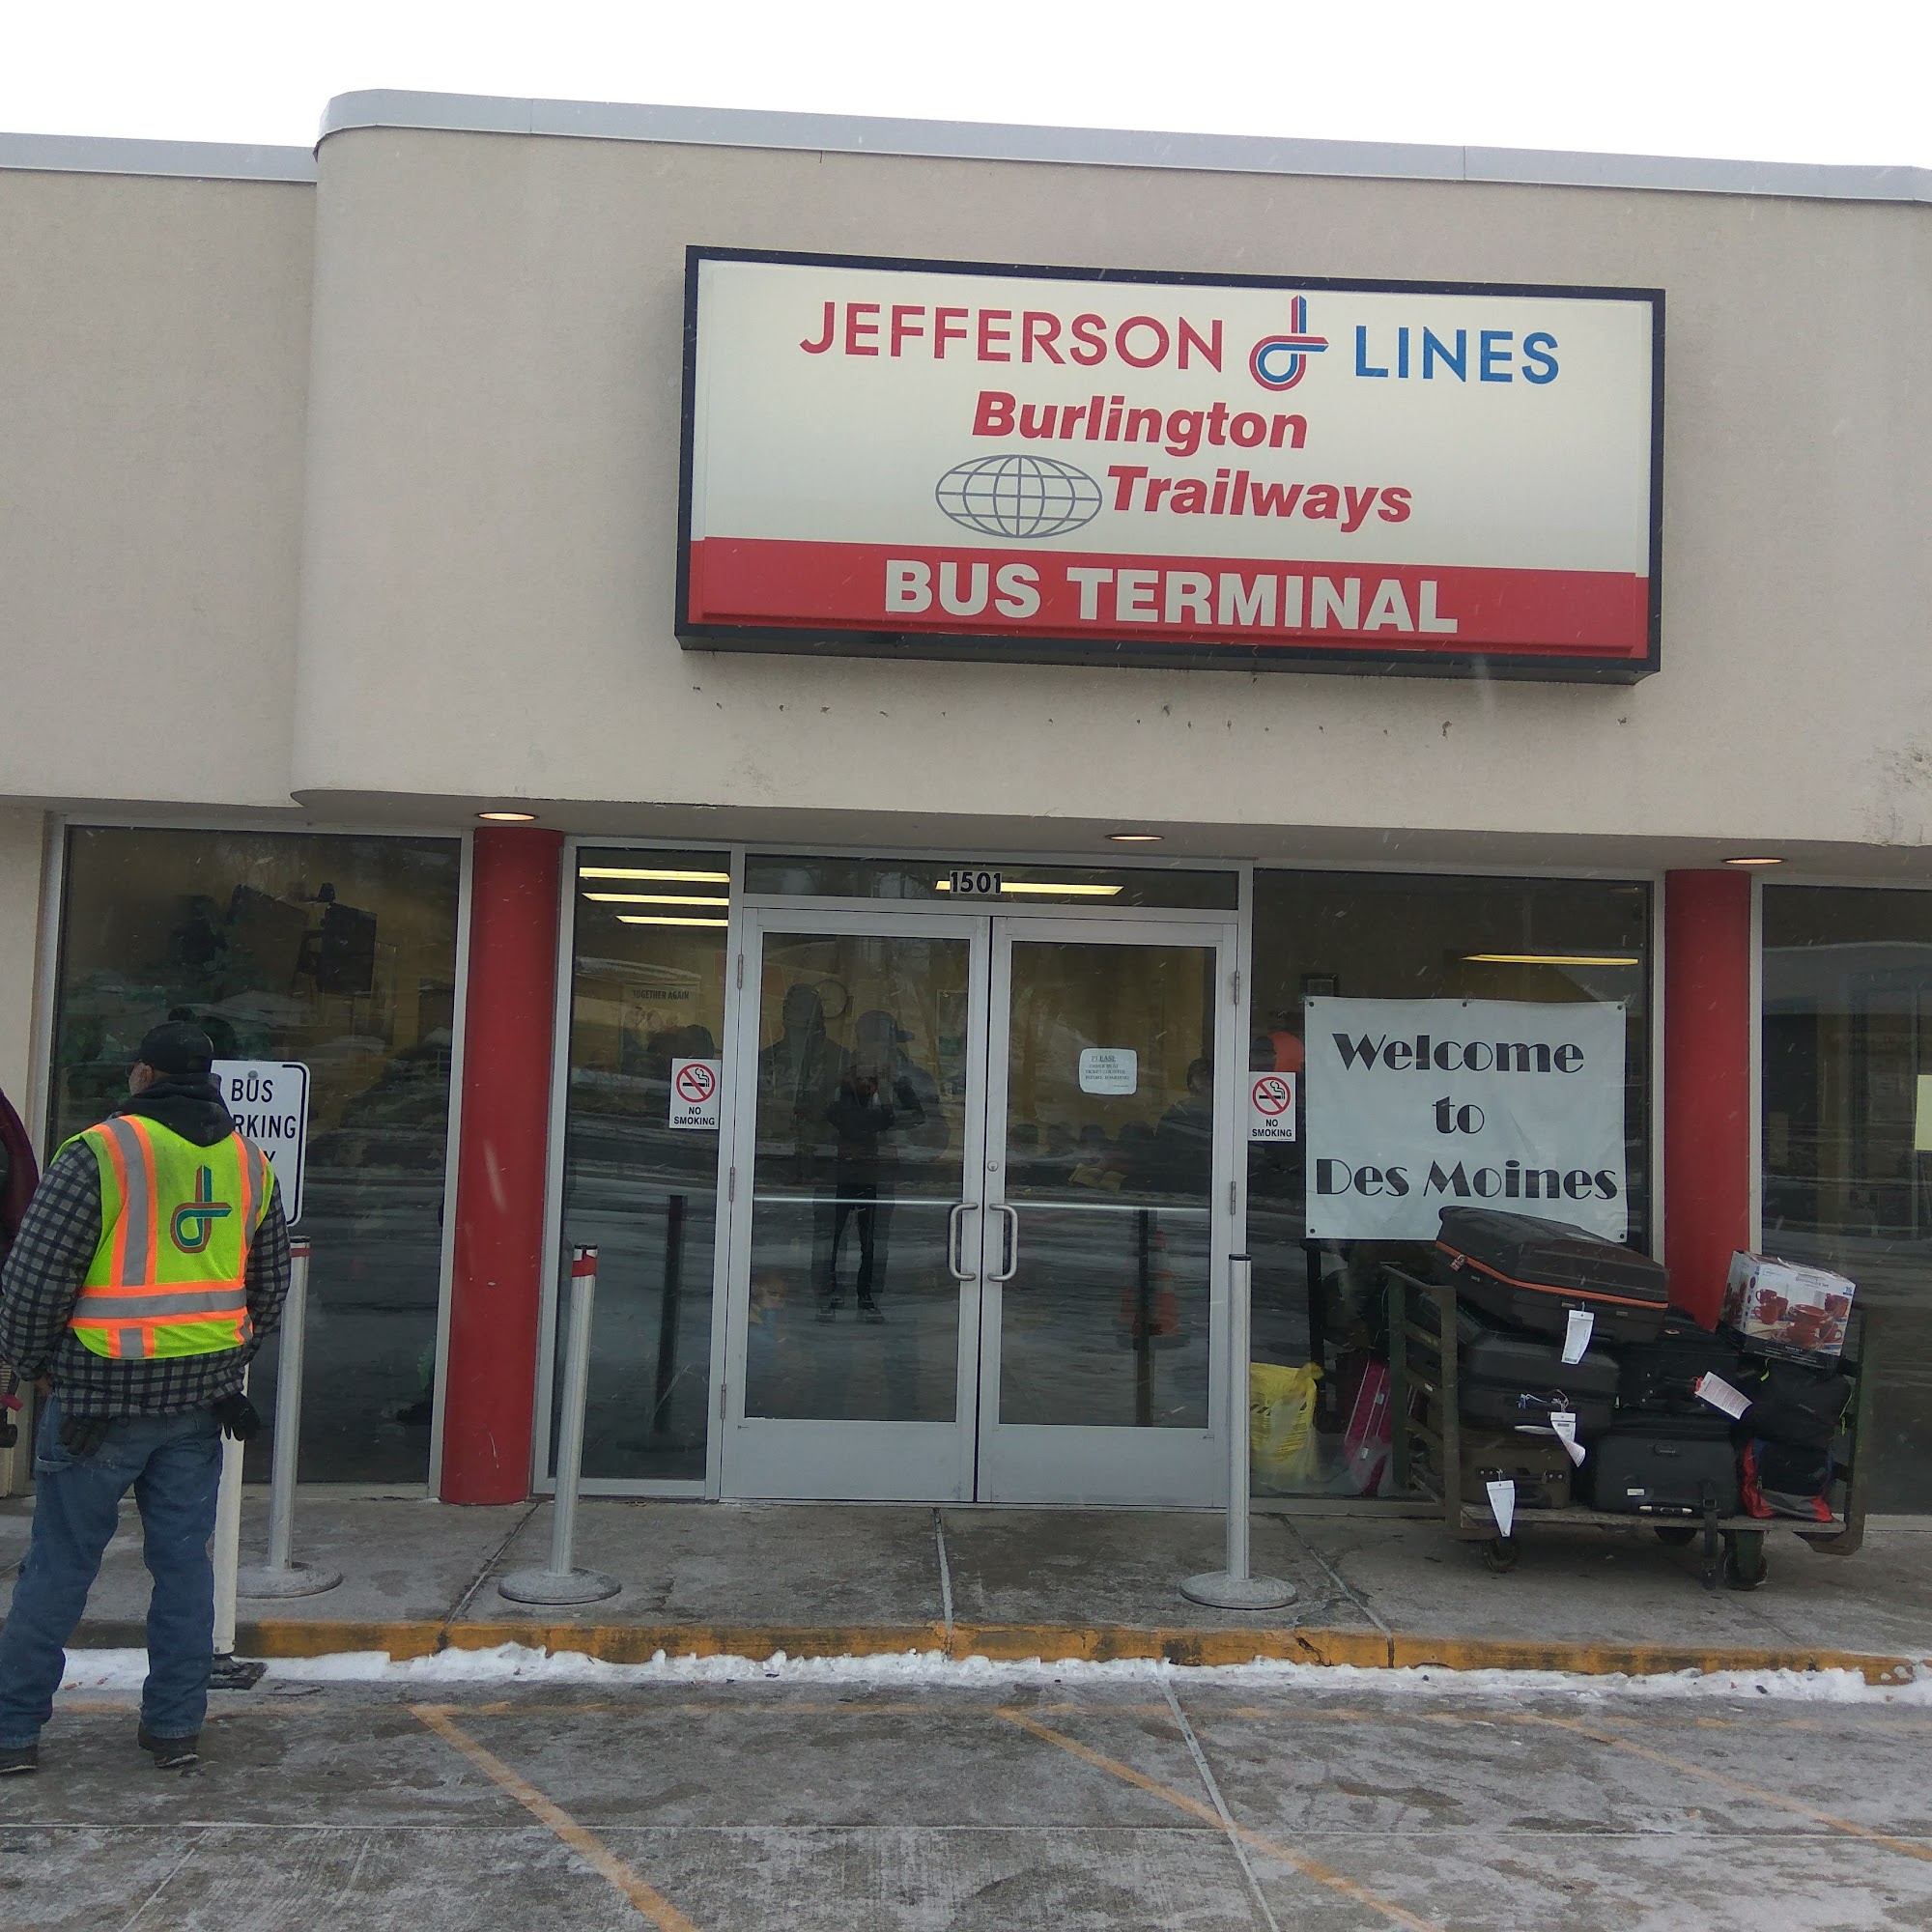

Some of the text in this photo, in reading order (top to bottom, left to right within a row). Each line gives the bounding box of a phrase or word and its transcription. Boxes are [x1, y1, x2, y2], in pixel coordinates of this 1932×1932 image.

[800, 301, 1560, 384] JEFFERSON LINES
[972, 391, 1307, 458] Burlington
[1107, 465, 1412, 533] Trailways
[884, 558, 1459, 636] BUS TERMINAL
[951, 871, 1001, 894] 1501
[633, 989, 690, 1000] TOGETHER AGAIN
[1331, 1033, 1584, 1074] Welcome
[231, 1078, 274, 1103] BUS
[673, 1116, 716, 1126] SMOKING
[688, 1106, 702, 1116] NO
[1265, 1119, 1279, 1128] NO
[1432, 1095, 1486, 1135] to
[233, 1114, 298, 1139] RKING
[1251, 1128, 1293, 1138] SMOKING
[1316, 1158, 1619, 1202] Des Moines
